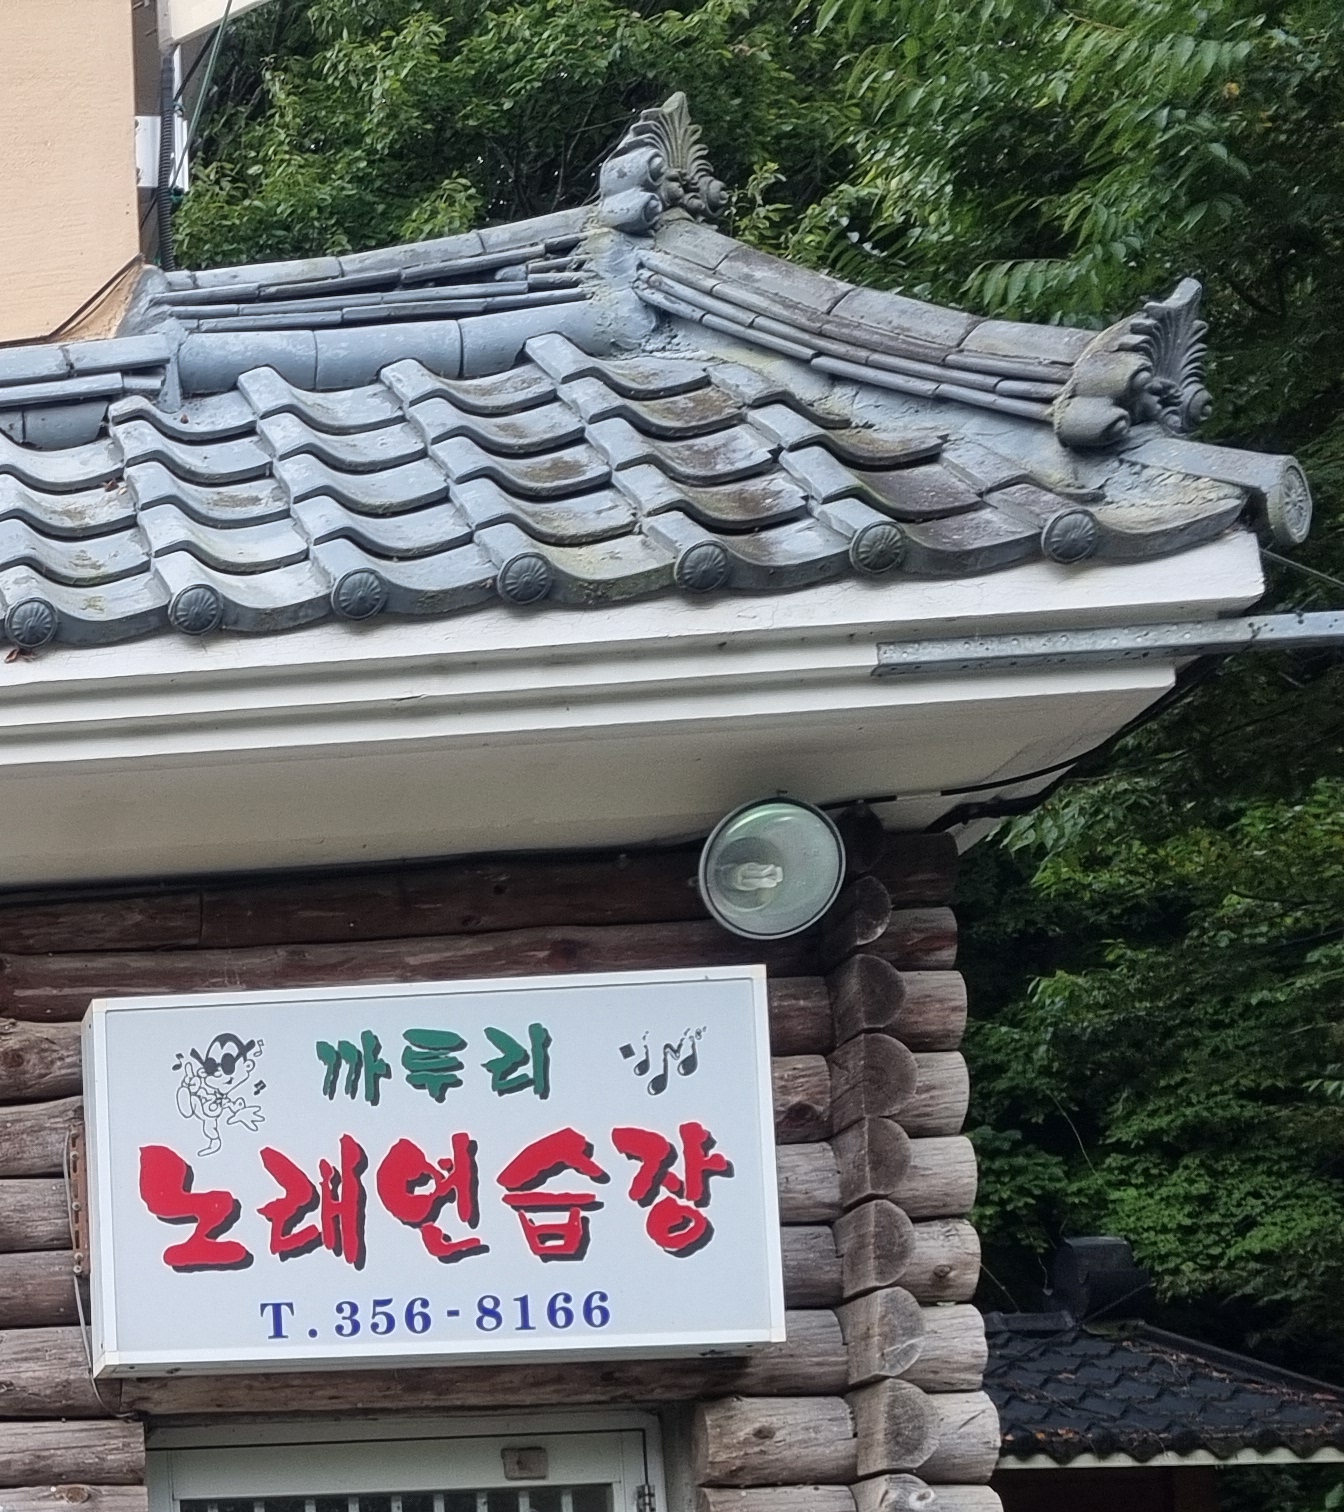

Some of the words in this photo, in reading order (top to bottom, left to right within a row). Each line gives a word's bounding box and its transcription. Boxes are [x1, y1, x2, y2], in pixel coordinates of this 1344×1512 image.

[315, 1022, 553, 1107] 까투리
[139, 1121, 735, 1272] 노래연습장
[260, 1290, 612, 1340] T.356-8166
